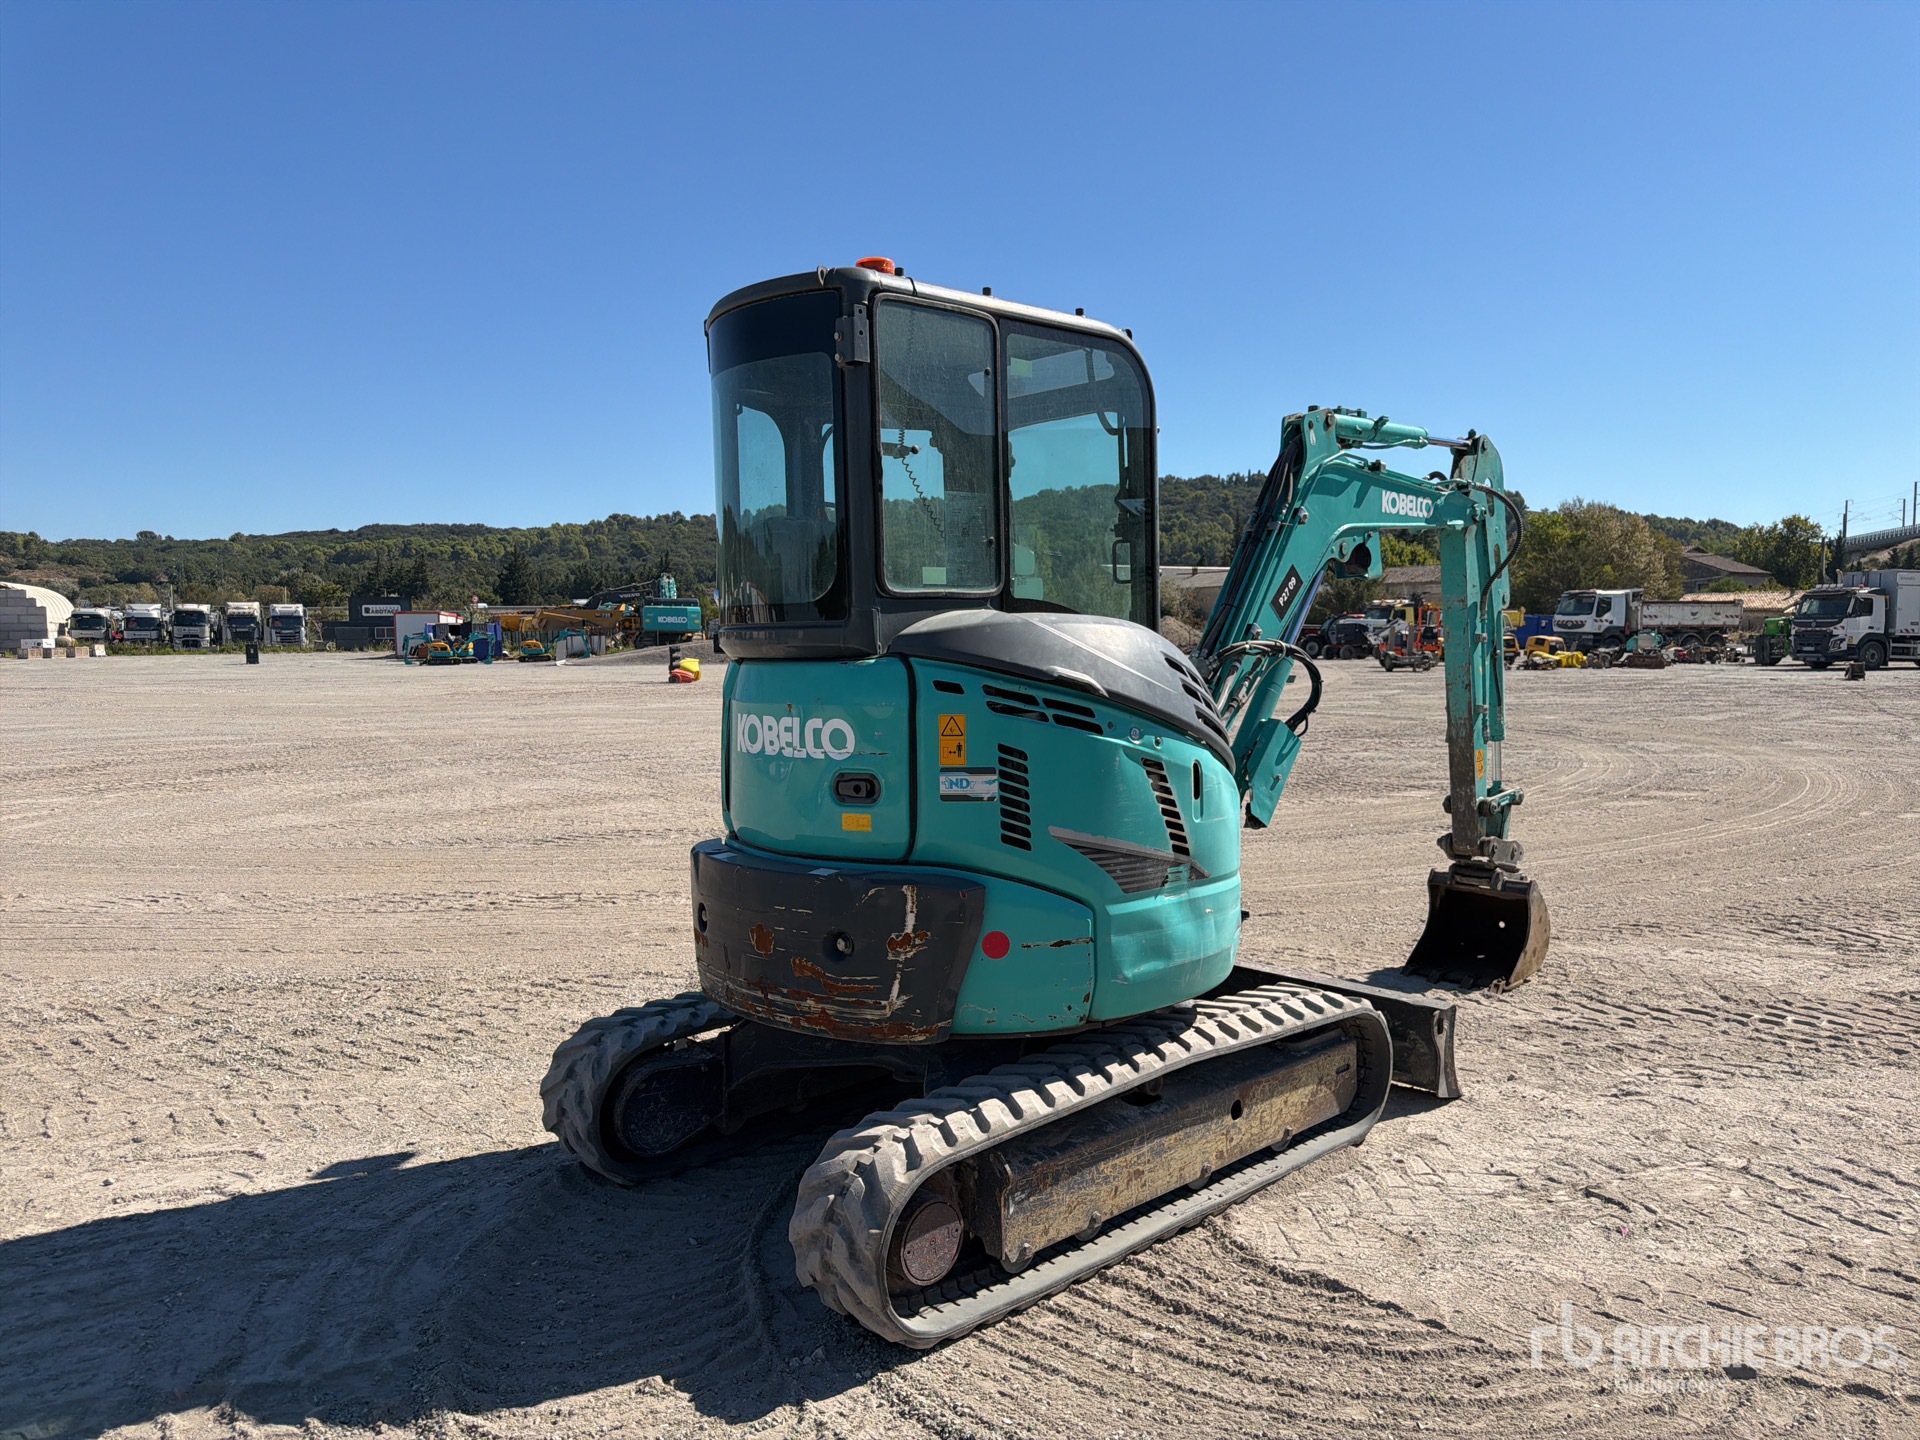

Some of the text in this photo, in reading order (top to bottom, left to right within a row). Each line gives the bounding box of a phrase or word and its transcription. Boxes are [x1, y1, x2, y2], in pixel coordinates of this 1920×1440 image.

[1381, 490, 1434, 518] KOBELCO
[1278, 576, 1297, 607] P27 09
[657, 616, 688, 624] KOBELCO
[737, 712, 856, 761] KOBELCO
